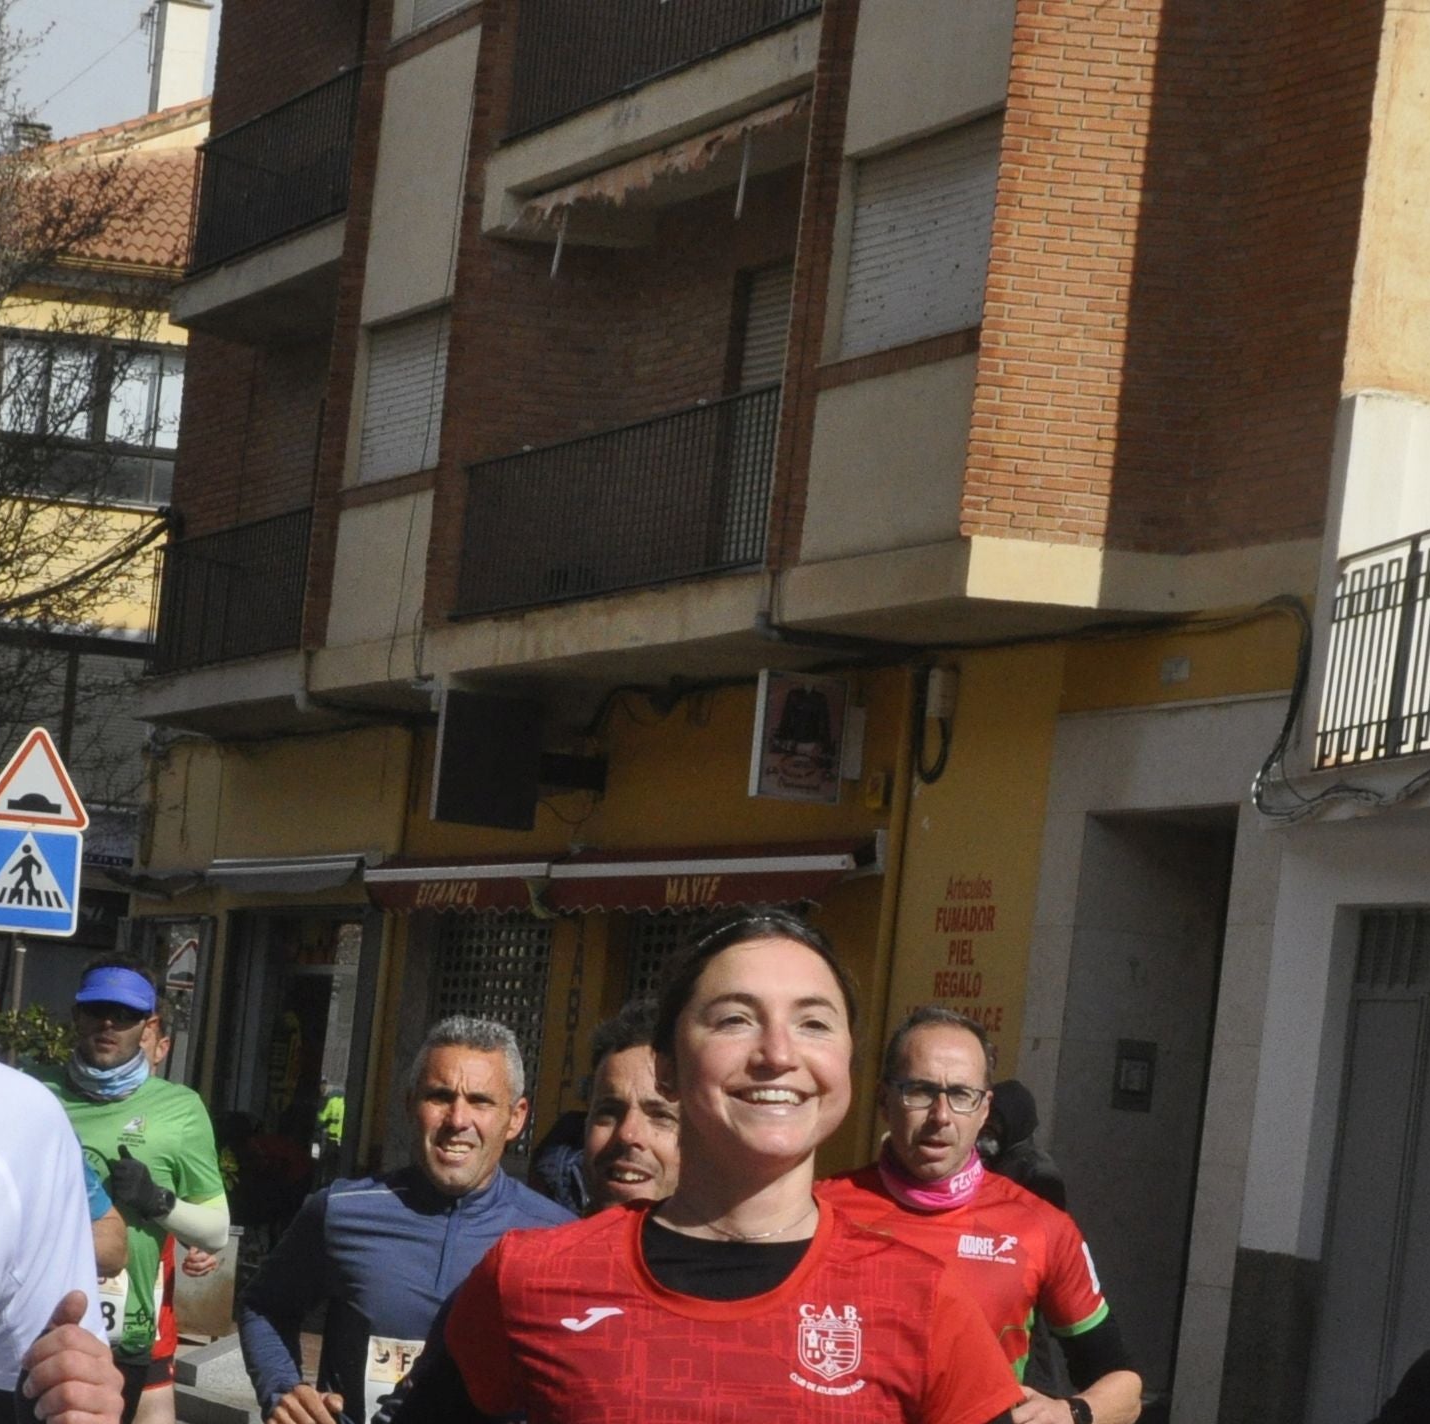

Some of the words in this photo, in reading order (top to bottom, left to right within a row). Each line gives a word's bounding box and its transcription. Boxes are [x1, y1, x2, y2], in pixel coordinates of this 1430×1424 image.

[666, 876, 720, 904] MAYTE
[935, 905, 996, 933] FUMADOR
[948, 939, 975, 966] PIEL
[933, 971, 982, 998] REGALO
